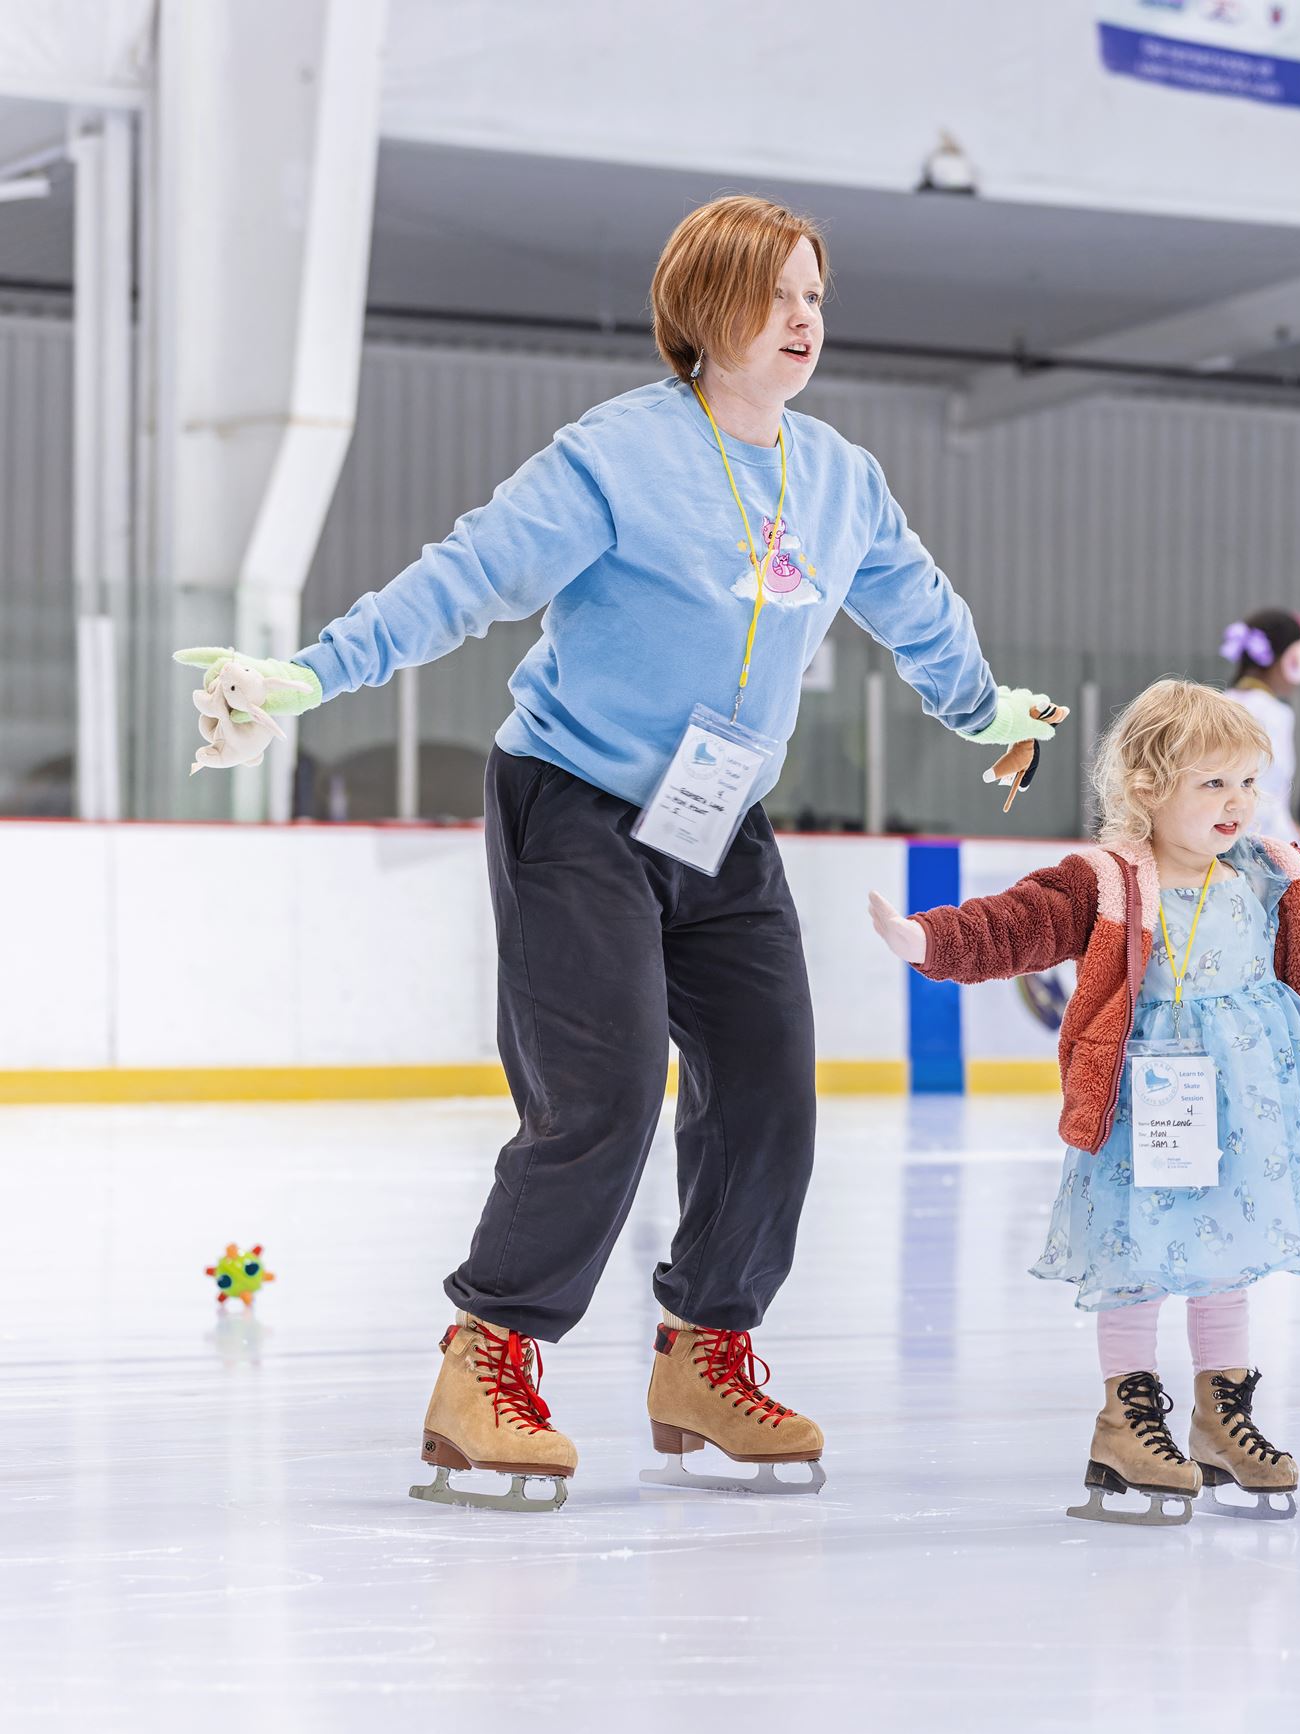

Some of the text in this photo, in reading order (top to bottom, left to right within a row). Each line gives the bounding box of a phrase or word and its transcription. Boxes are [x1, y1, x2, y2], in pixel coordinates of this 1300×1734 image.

[1186, 1104, 1193, 1116] 4
[1172, 1119, 1192, 1127] LONG
[1151, 1140, 1168, 1148] SAM
